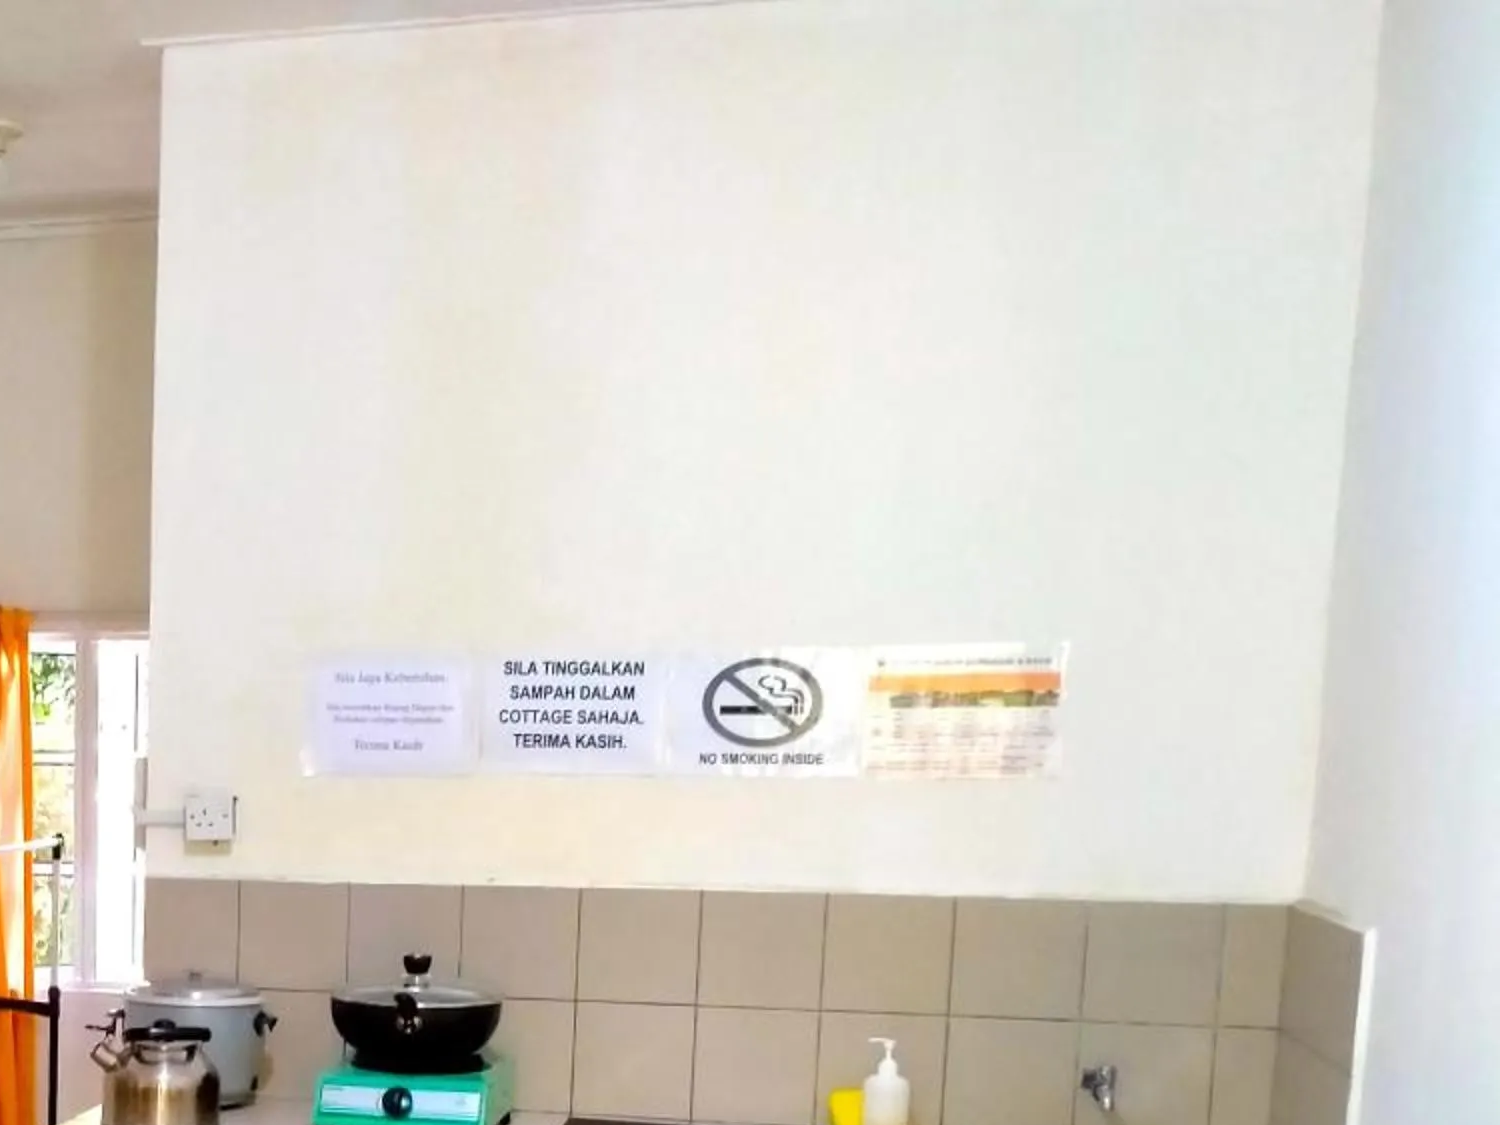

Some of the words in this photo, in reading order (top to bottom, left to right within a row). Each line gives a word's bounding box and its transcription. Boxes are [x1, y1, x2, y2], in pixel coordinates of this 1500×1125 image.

[503, 660, 538, 677] SILA
[542, 660, 645, 677] TINGGALKAN
[509, 685, 576, 701] SAMPAH
[579, 685, 636, 701] DALAM
[499, 709, 573, 725] COTTAGE
[577, 709, 645, 725] SAHAJA.
[512, 733, 572, 749] TERIMA
[575, 733, 628, 749] KASIH.
[698, 752, 718, 765] NO
[720, 752, 779, 765] SMOKING
[781, 752, 824, 765] INSIDE
